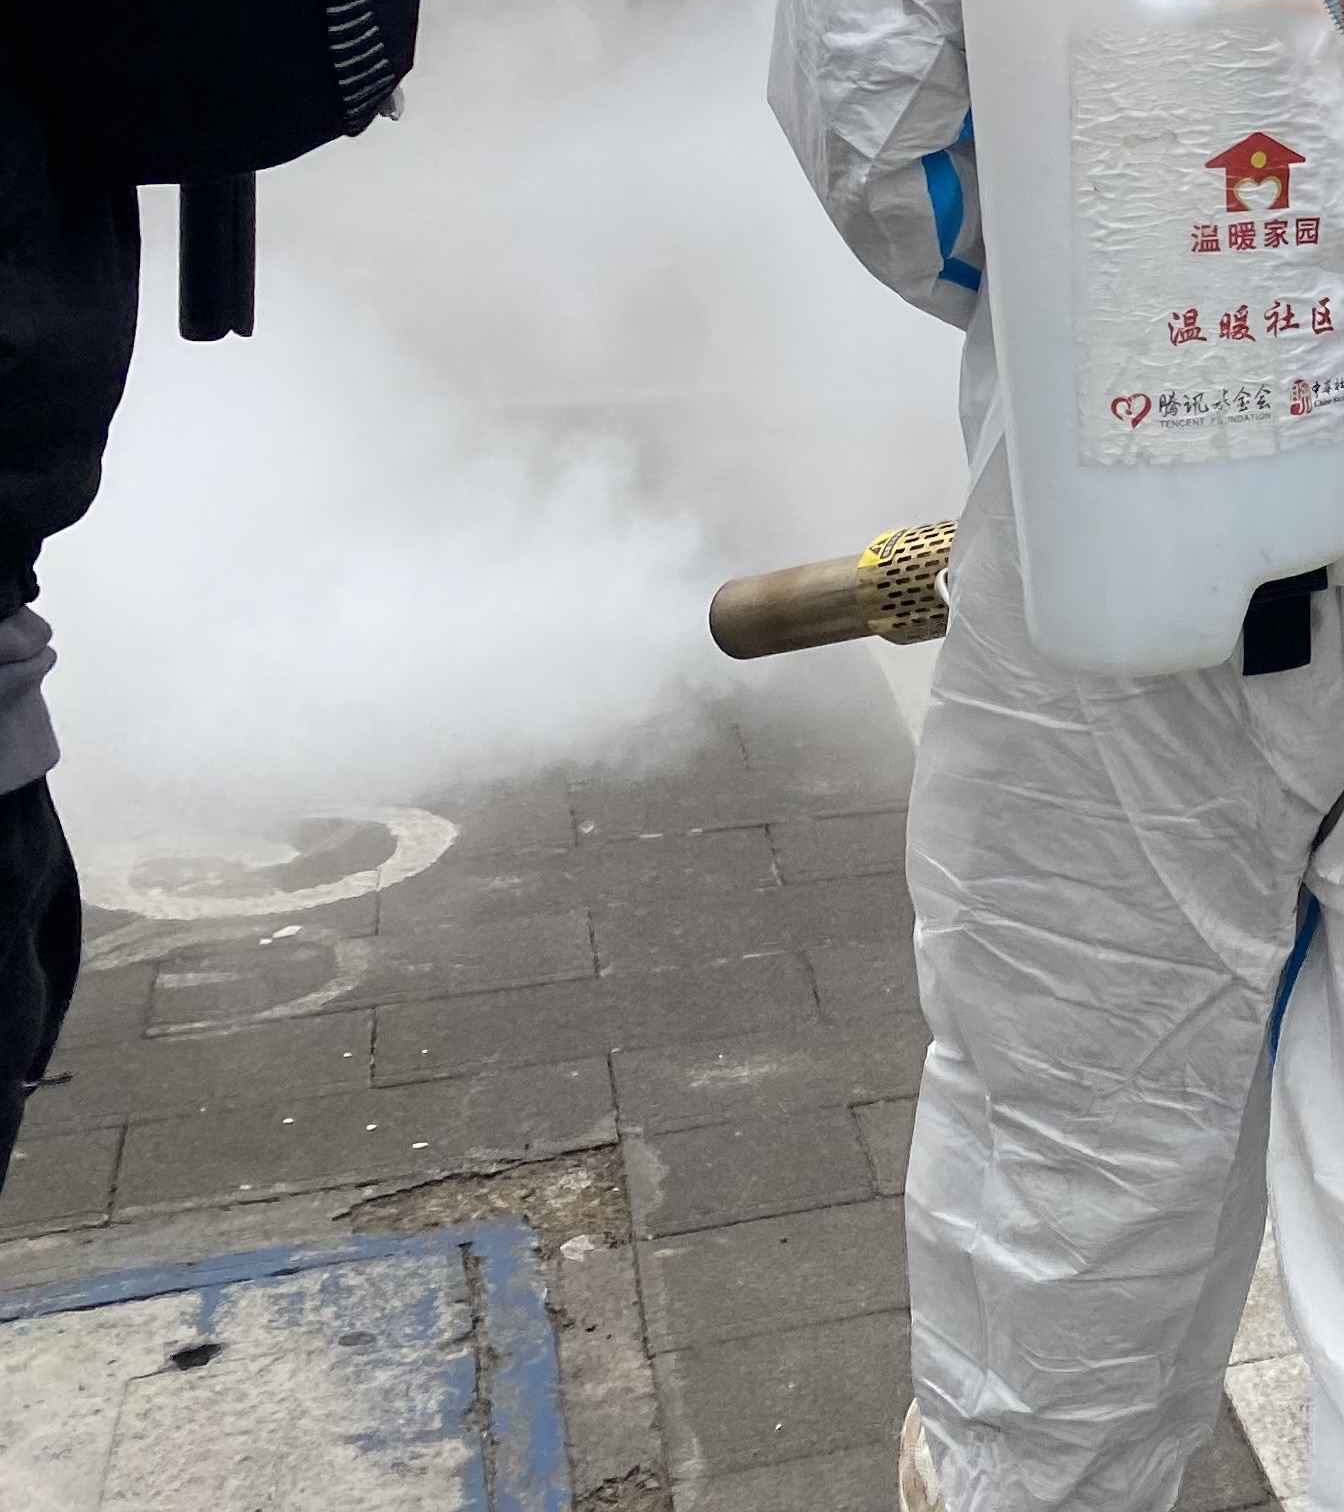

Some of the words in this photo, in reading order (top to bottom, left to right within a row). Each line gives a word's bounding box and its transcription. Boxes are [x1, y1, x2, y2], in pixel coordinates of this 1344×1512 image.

[1190, 216, 1322, 253] 温暖家园
[1166, 296, 1336, 347] 温暖社区
[1159, 418, 1205, 429] TENCENT
